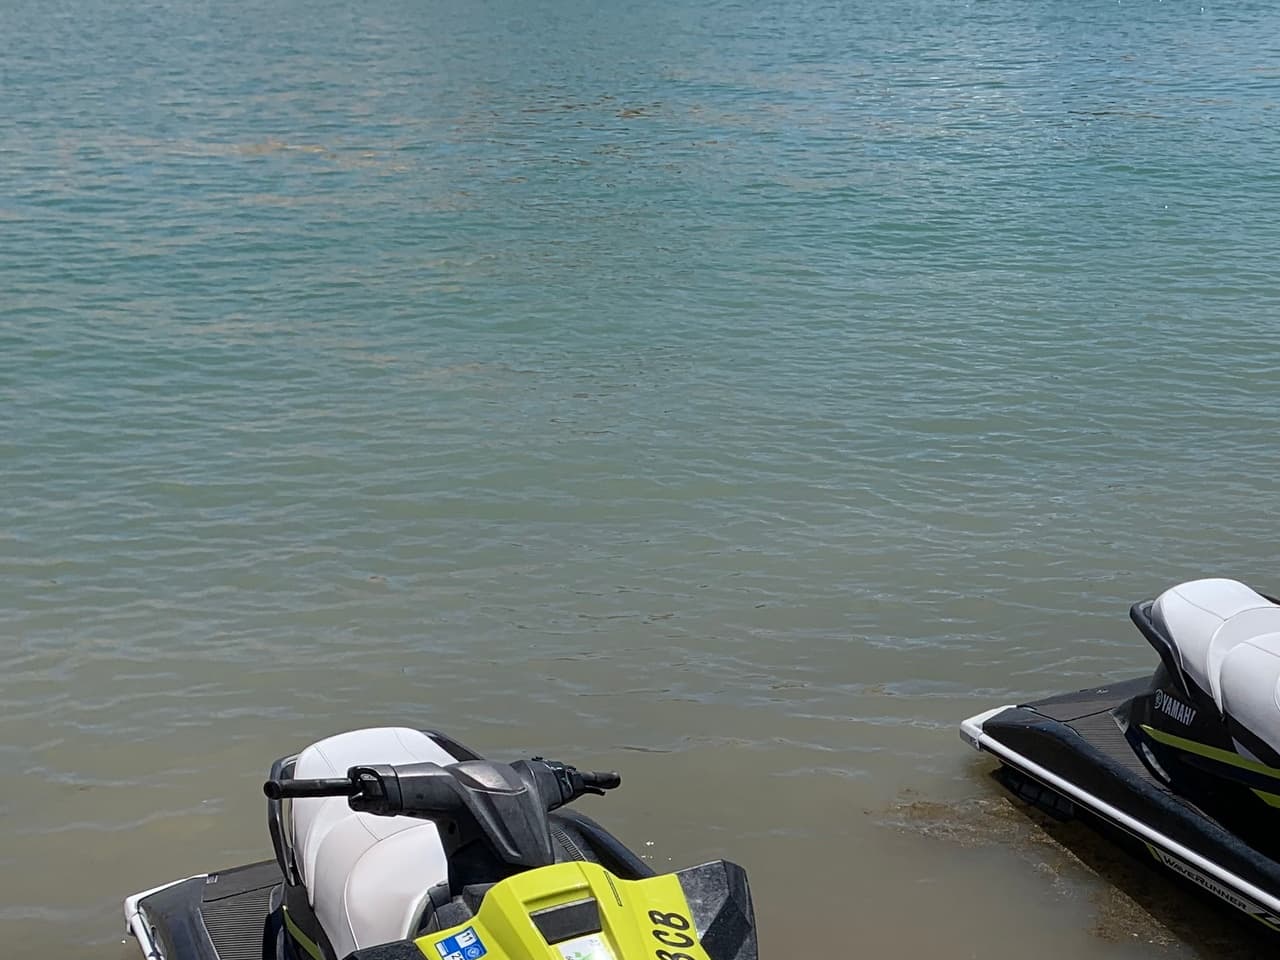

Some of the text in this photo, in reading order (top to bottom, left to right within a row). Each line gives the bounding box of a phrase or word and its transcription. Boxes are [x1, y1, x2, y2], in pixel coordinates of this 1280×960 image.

[1162, 854, 1248, 911] WAVERUNNER
[461, 931, 474, 943] 11
[648, 910, 695, 949] CB
